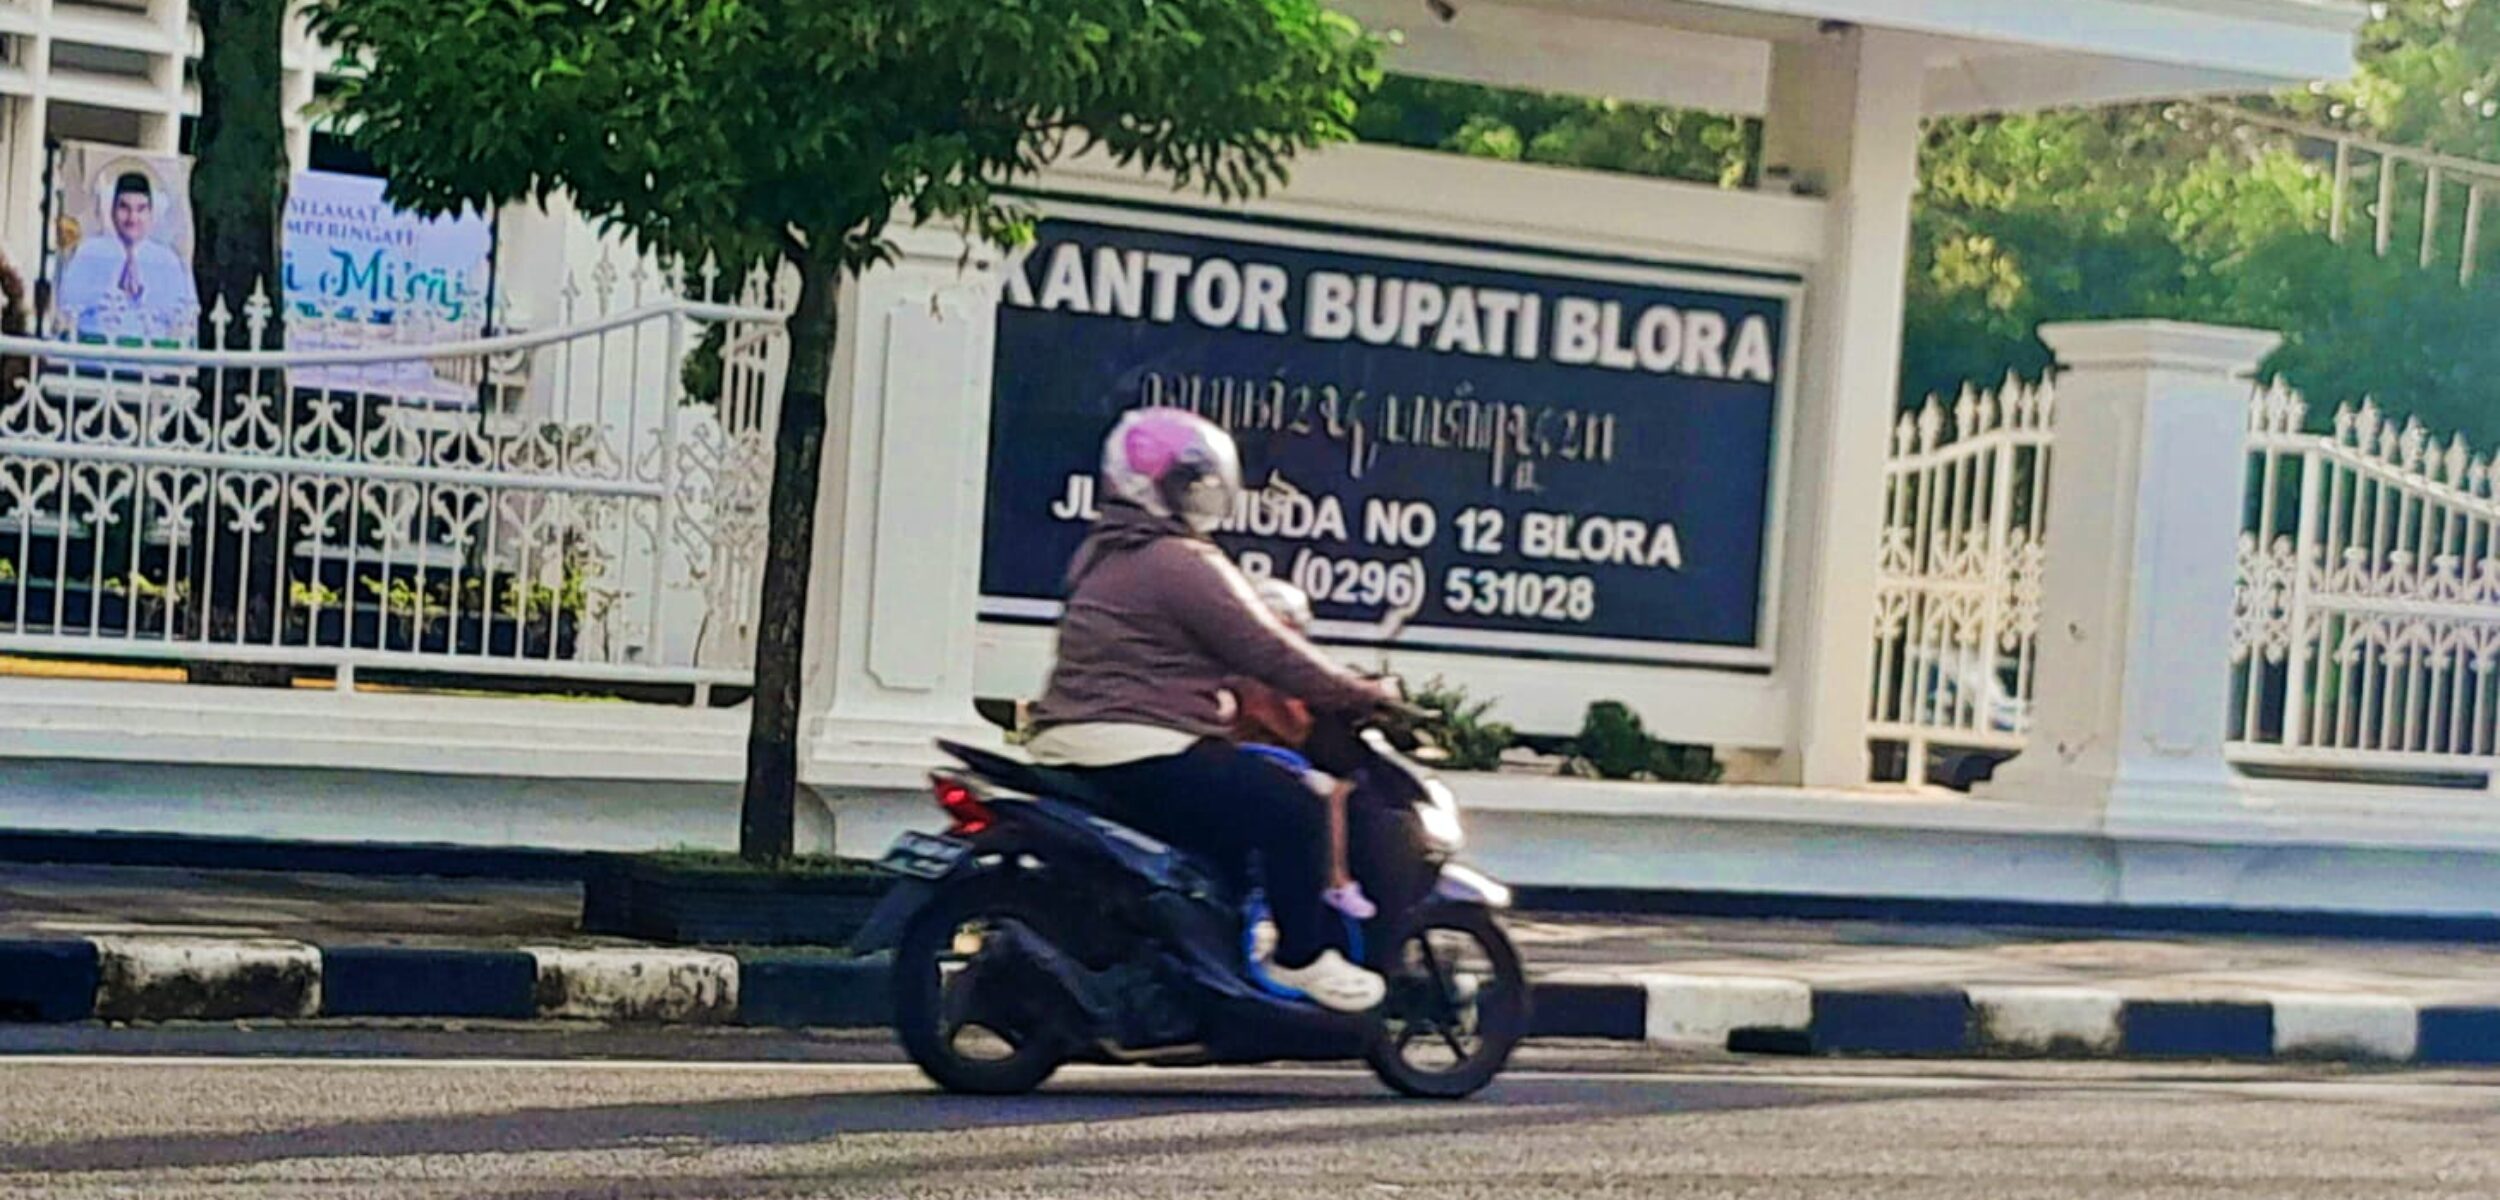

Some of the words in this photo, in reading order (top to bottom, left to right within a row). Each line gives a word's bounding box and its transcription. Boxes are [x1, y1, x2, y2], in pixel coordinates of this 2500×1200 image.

[999, 239, 1288, 333] KANTOR
[1308, 271, 1541, 360] BUPATI
[1553, 299, 1773, 383] BLORA
[1364, 498, 1437, 546] NO
[1455, 508, 1504, 554] 12
[1519, 512, 1682, 568] BLORA
[1291, 548, 1426, 612] (0296)
[1444, 566, 1595, 622] 531028
